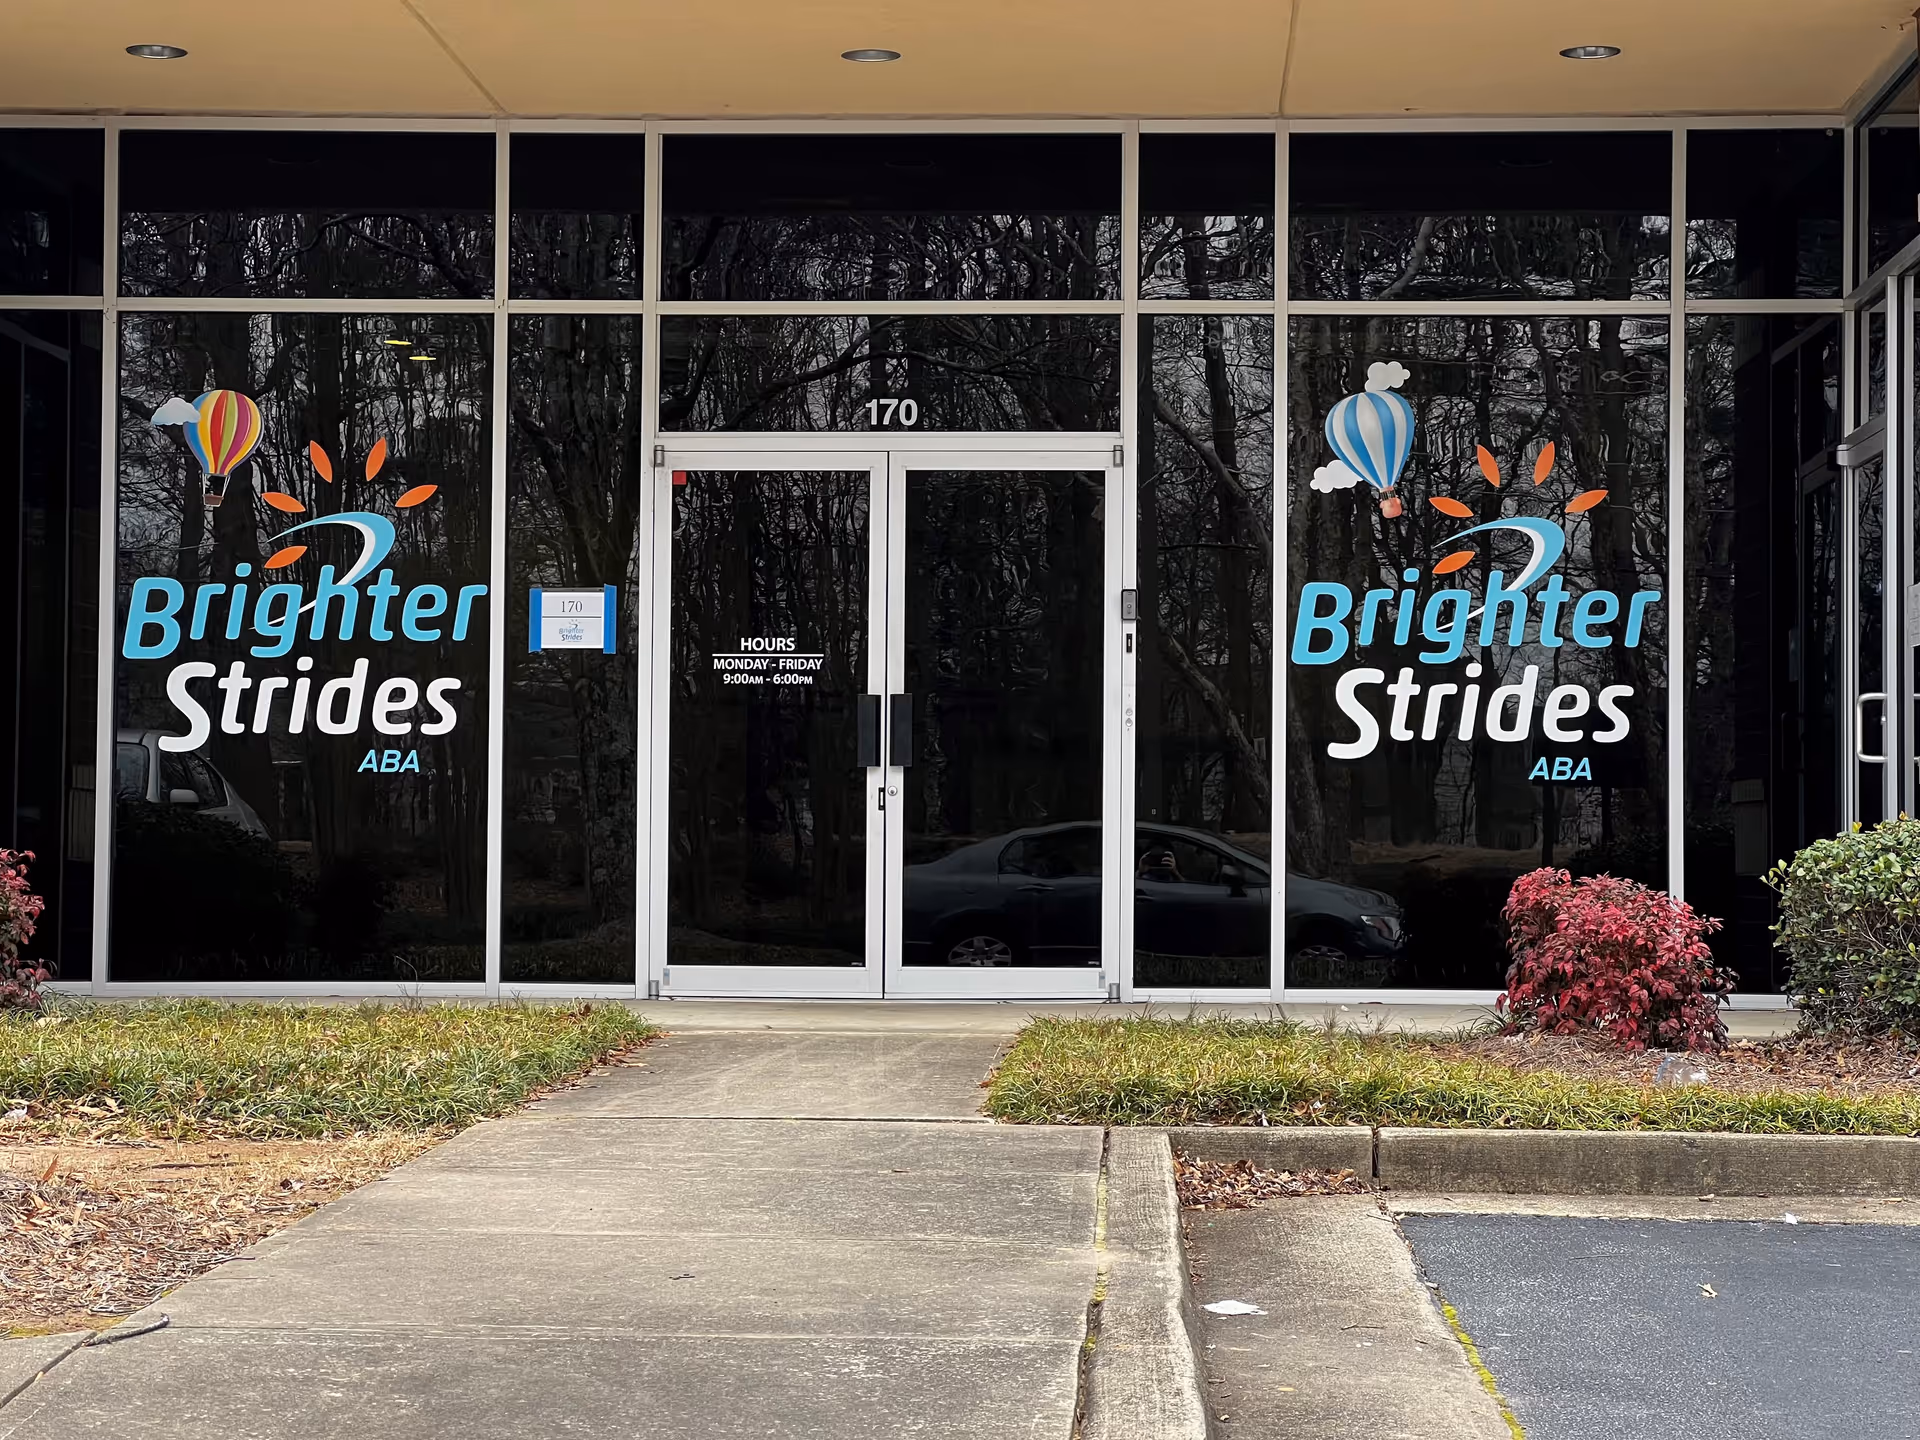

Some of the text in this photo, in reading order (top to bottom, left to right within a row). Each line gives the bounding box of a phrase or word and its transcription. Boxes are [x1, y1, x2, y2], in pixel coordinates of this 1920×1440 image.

[865, 398, 917, 426] 170
[122, 563, 488, 659] Brighter
[561, 600, 583, 613] 170
[1291, 568, 1662, 665] Brighter
[740, 637, 795, 651] HOURS
[713, 658, 769, 669] MONDAY
[779, 658, 823, 669] FRIDAY
[723, 673, 764, 684] 9:00AM
[773, 673, 813, 684] 6:00PM
[158, 656, 462, 753] Strides
[1327, 663, 1635, 759] Strides
[357, 749, 420, 773] ABA
[1528, 757, 1592, 781] ABA
